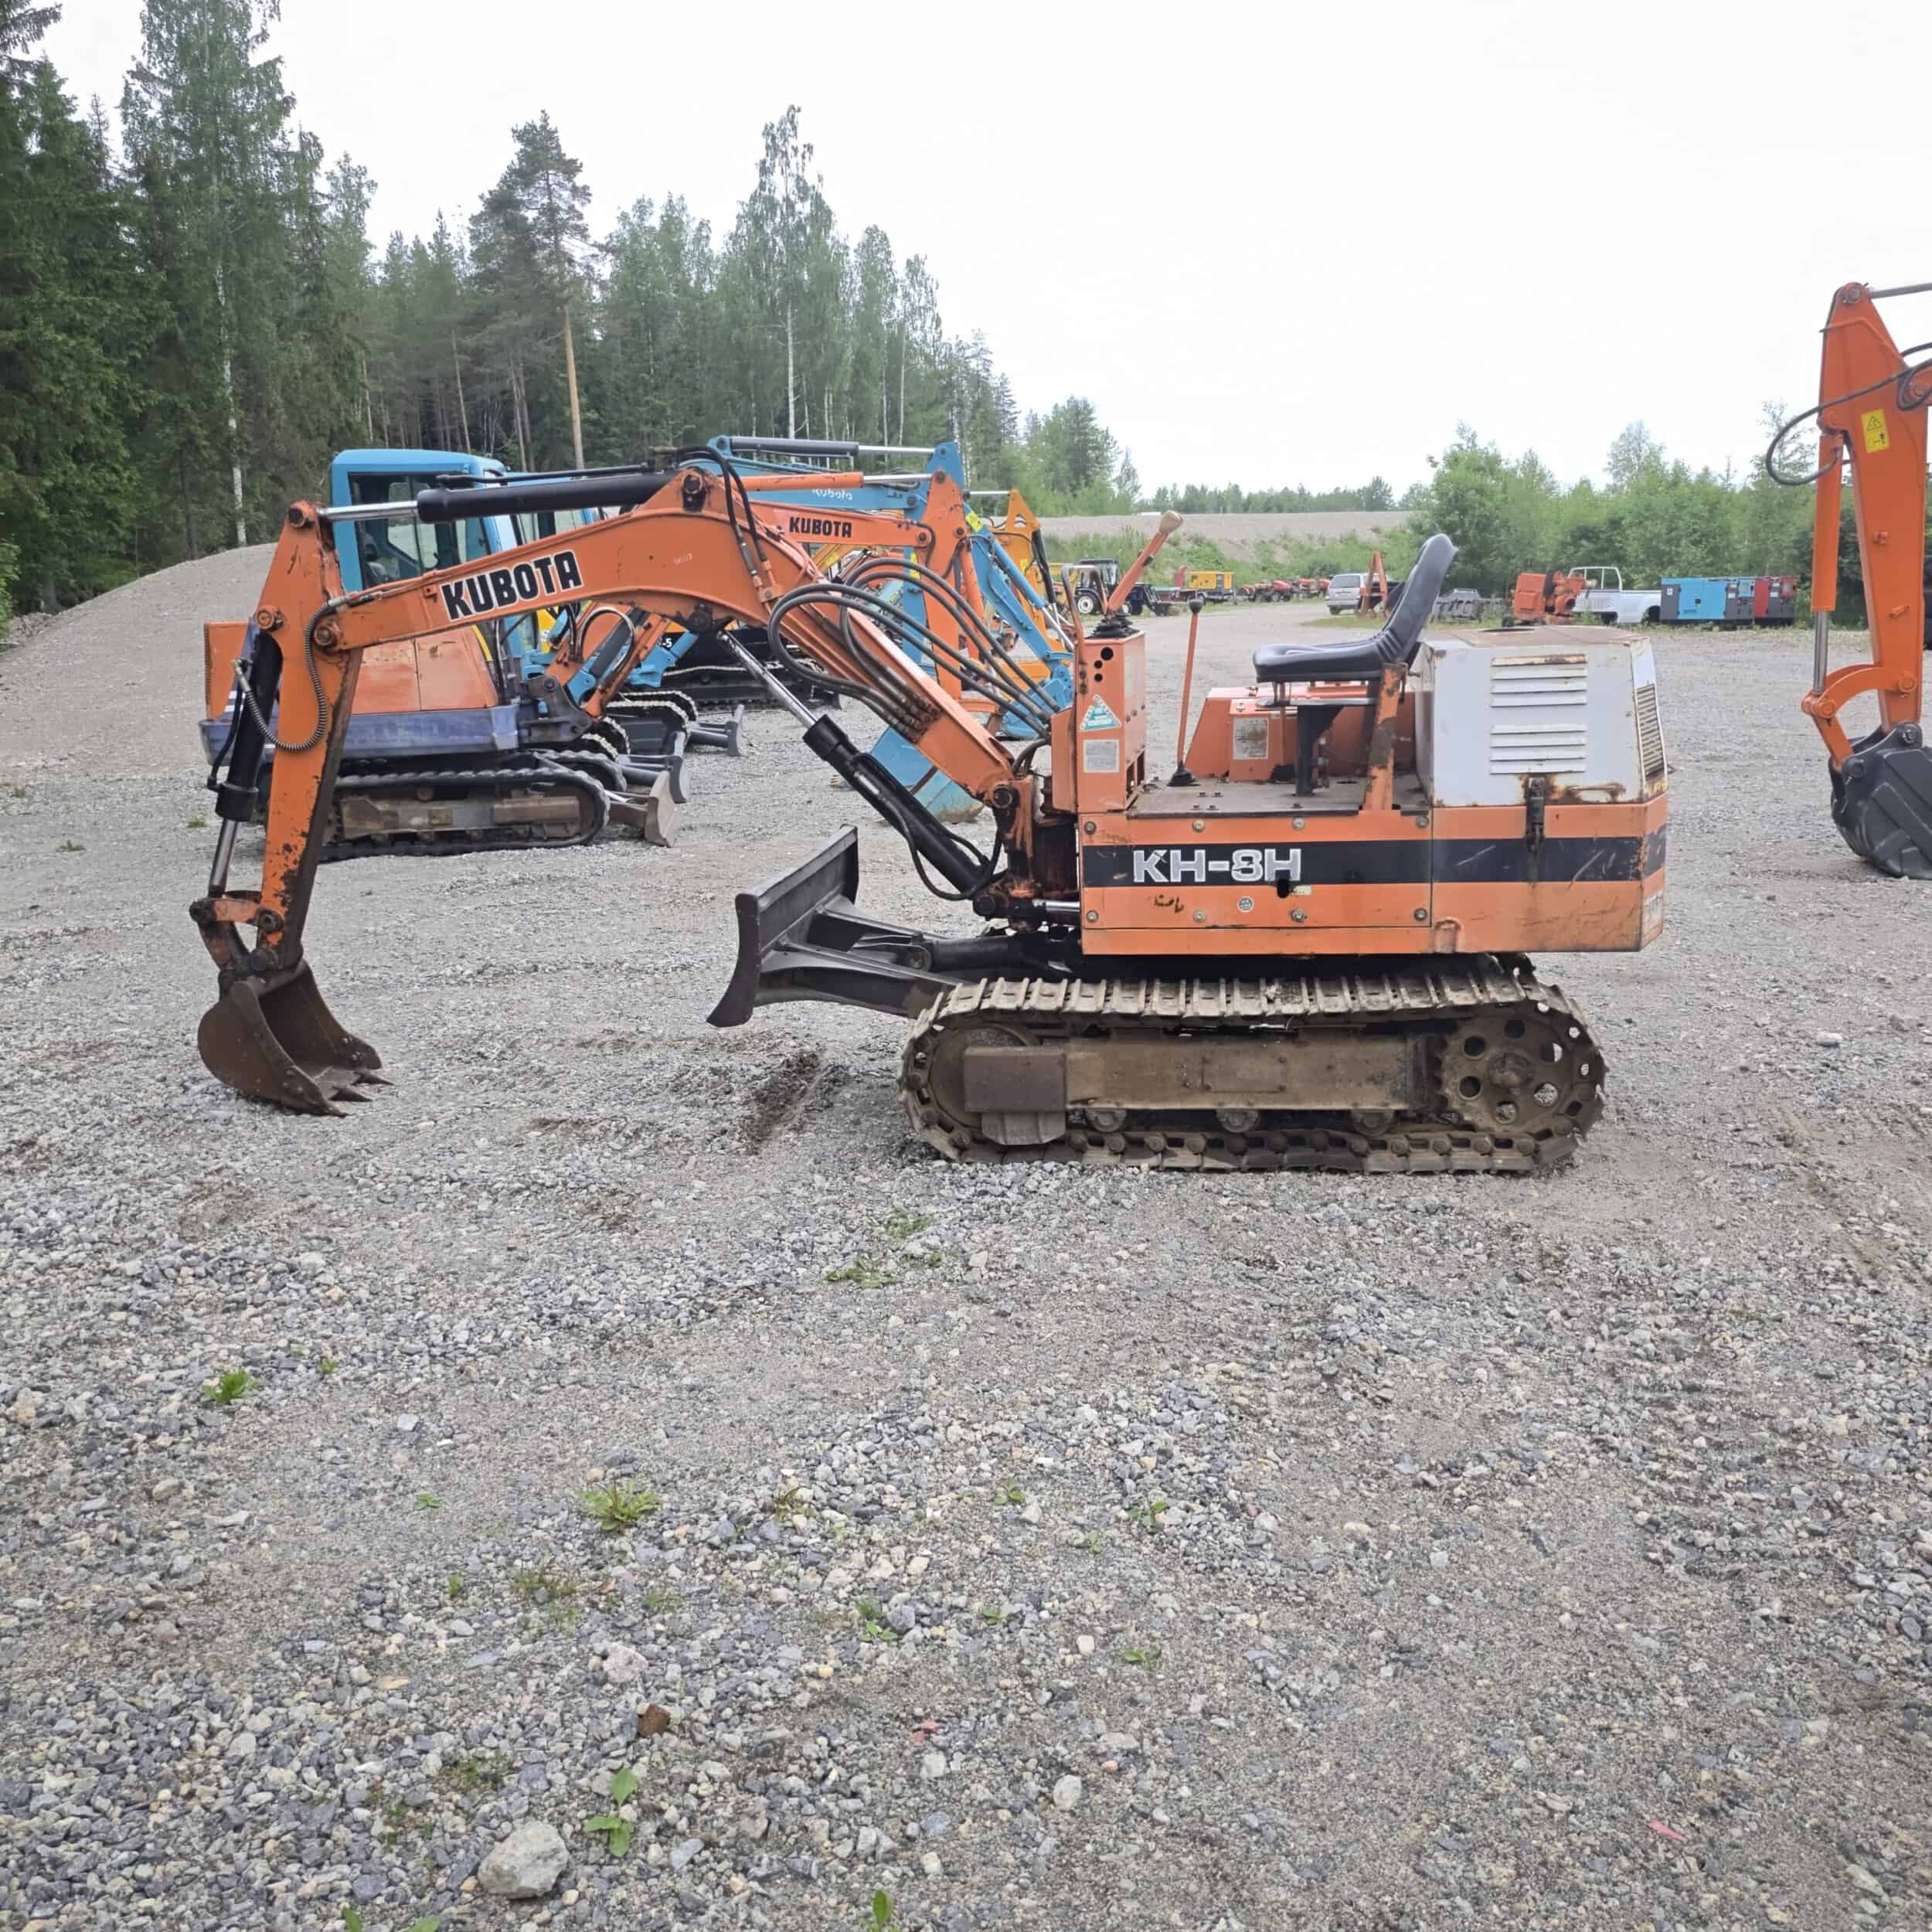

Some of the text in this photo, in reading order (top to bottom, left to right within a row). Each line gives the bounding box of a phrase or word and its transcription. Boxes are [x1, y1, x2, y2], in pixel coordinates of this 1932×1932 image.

[789, 516, 852, 538] KUBOTA
[440, 550, 583, 621] KUBOTA
[1133, 849, 1301, 883] KH-8H
